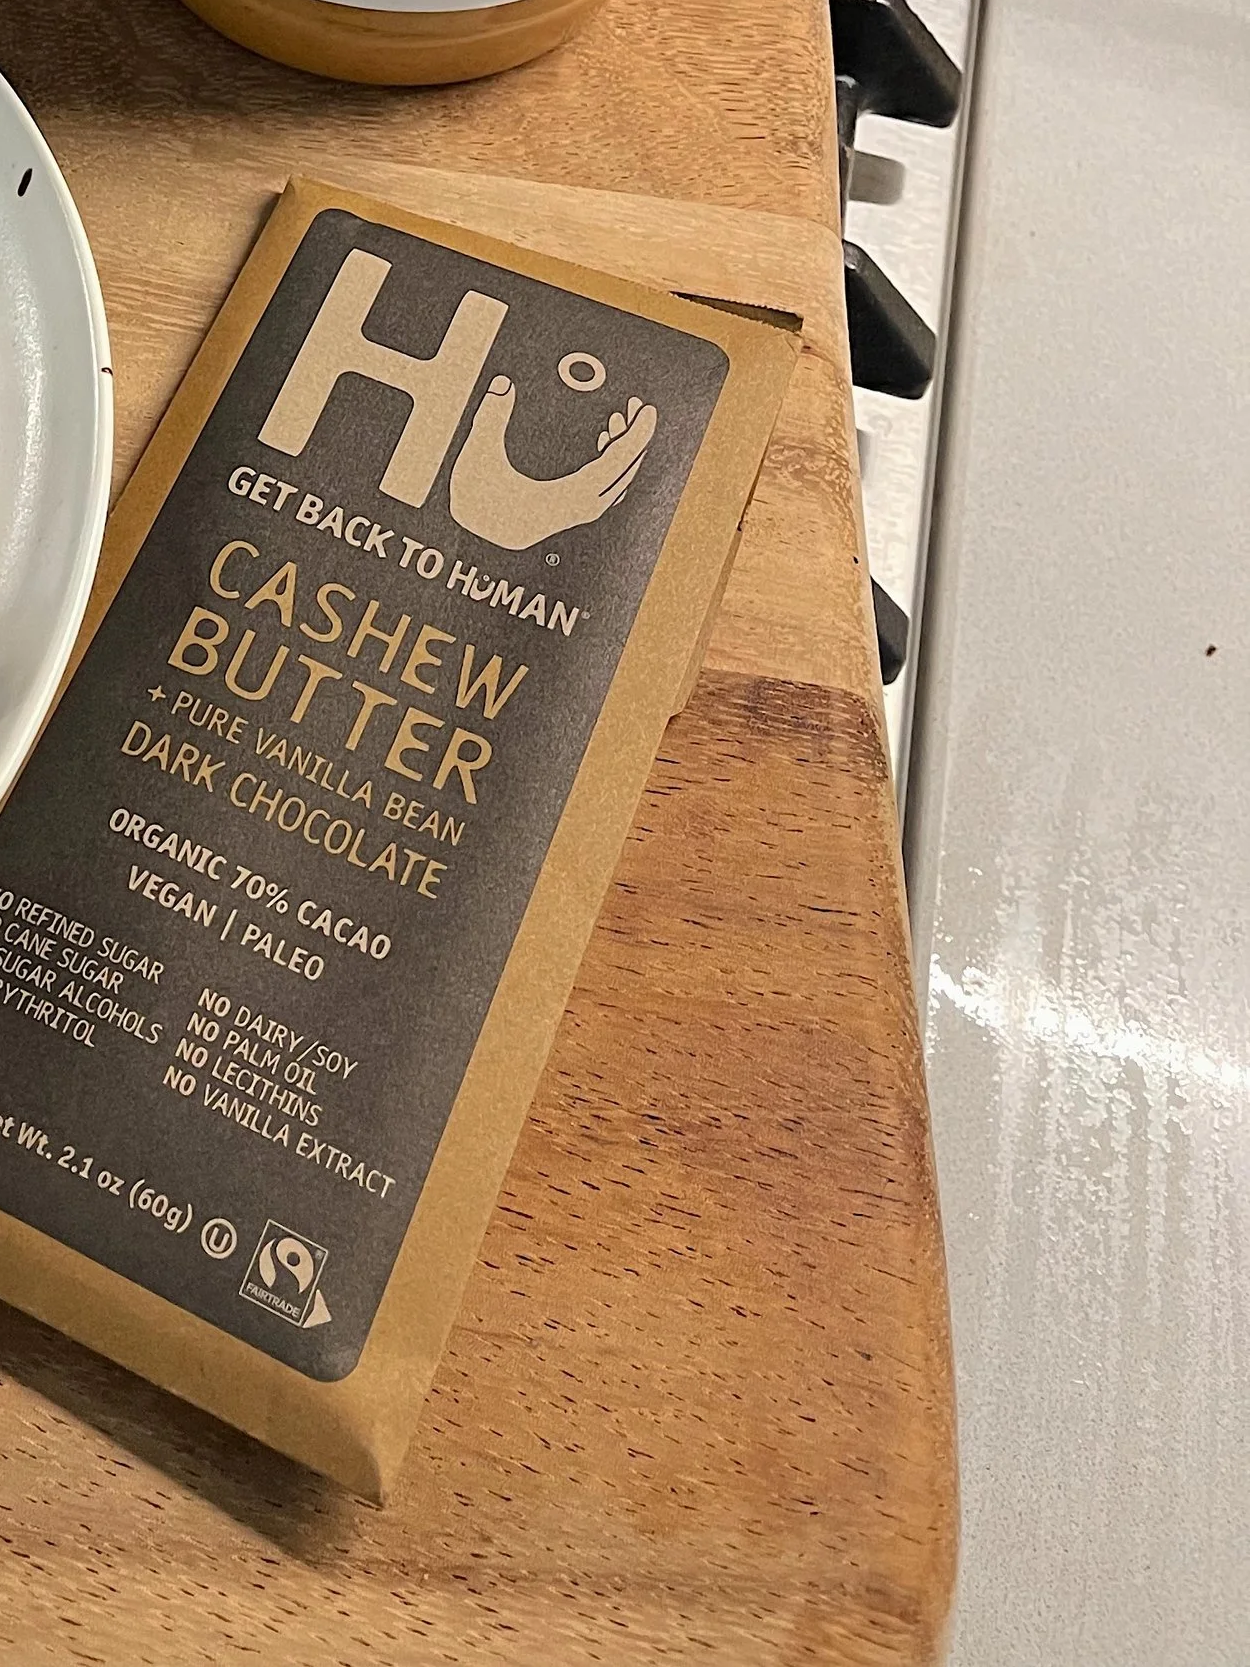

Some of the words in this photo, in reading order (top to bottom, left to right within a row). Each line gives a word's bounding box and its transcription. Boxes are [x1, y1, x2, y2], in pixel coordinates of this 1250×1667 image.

[227, 465, 299, 512] GET
[295, 493, 395, 559] BACK
[399, 536, 445, 579] TO
[208, 540, 530, 722] CASHEW
[166, 605, 493, 805] BUTTER
[120, 720, 226, 793] DARK
[229, 772, 449, 900] CHOCOLATE
[170, 690, 250, 745] PURE
[254, 727, 373, 809] VANILLA
[382, 791, 466, 847] BEAN
[15, 897, 95, 948] REFINED
[97, 937, 165, 984] SUGAR
[108, 808, 228, 881] ORGANIC
[230, 865, 290, 914] 70%
[296, 900, 392, 960] CACAO
[127, 865, 218, 927] VEGAN
[240, 923, 325, 981] PALEO
[4, 922, 58, 961] CANE
[56, 947, 125, 995] SUGAR
[58, 980, 164, 1045] ALCOHOLS
[175, 1037, 208, 1069] NO
[211, 1055, 324, 1127] LECITHINS
[186, 1012, 220, 1042] NO
[222, 1030, 281, 1075] PALM
[284, 1061, 318, 1096] OIL
[197, 987, 231, 1018] NO
[233, 1005, 359, 1080] DAIRY/SOY
[16, 1122, 53, 1161] Wt.
[56, 1145, 94, 1180] 2.1
[96, 1170, 126, 1196] oz
[128, 1178, 193, 1234] (60g)
[162, 1065, 197, 1096] NO
[203, 1083, 290, 1148] VANILLA
[295, 1132, 397, 1200] EXTRACT
[244, 1282, 302, 1318] FAIRTRADE
